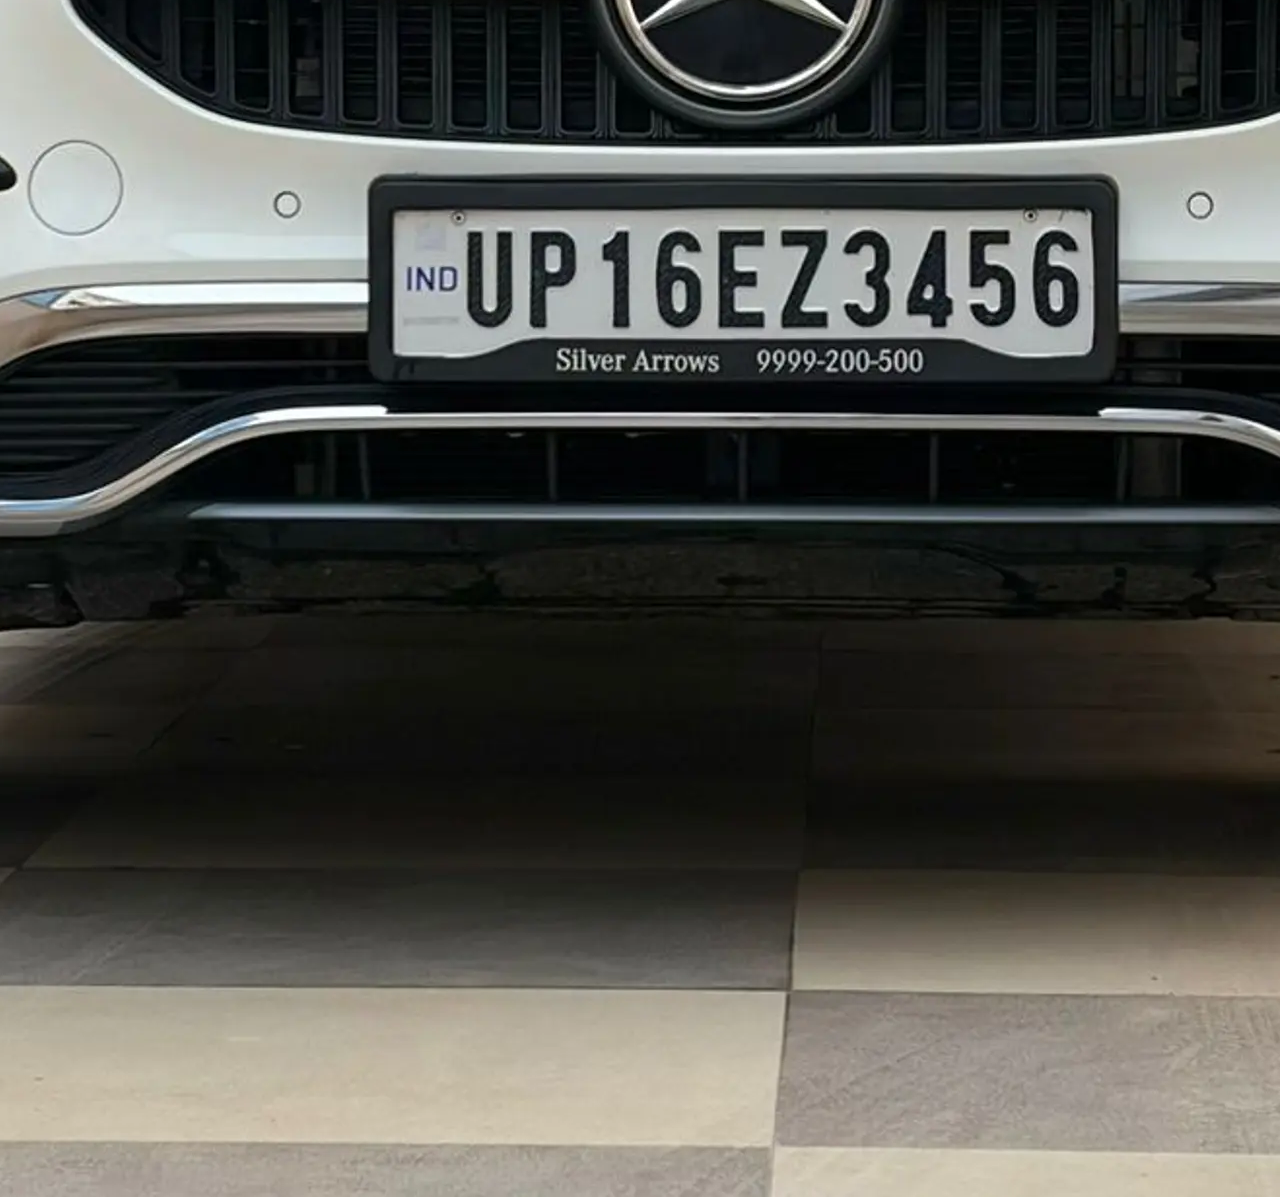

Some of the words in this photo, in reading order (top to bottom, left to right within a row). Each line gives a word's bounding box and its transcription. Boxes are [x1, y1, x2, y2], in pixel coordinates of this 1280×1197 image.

[406, 265, 458, 292] IND
[466, 230, 1080, 329] UP16EZ3456
[556, 348, 625, 372] Silver
[632, 349, 720, 373] Arrows
[756, 348, 924, 373] 9999-200-500
